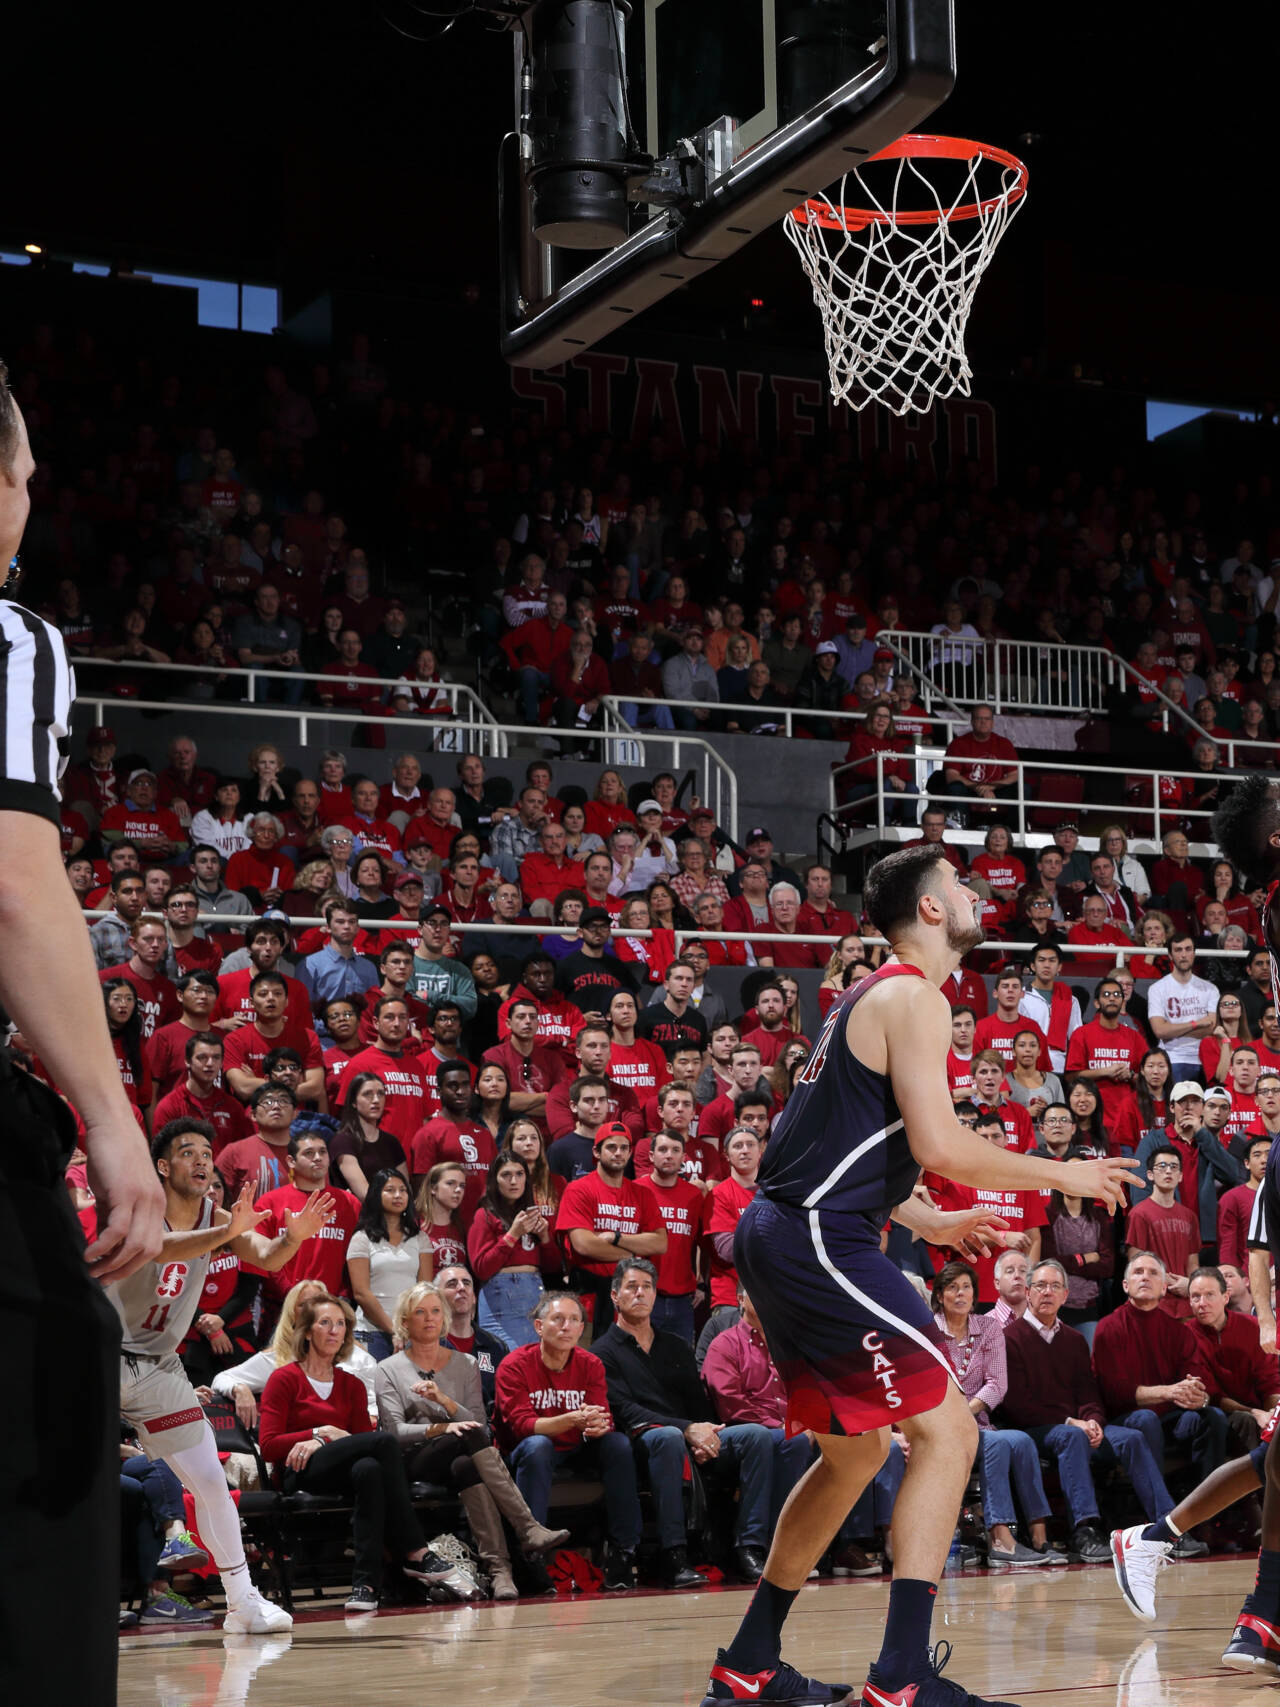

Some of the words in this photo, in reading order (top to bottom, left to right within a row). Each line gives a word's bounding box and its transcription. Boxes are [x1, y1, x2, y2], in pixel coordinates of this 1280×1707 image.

[438, 728, 458, 750] 12
[621, 741, 636, 762] 11
[1094, 1047, 1118, 1058] HOME
[1119, 1049, 1130, 1059] OF
[611, 1064, 637, 1075] HOME
[637, 1063, 650, 1074] OF
[384, 1071, 411, 1083] HOME
[977, 1190, 1003, 1203] HOME
[1004, 1193, 1017, 1204] OF
[597, 1203, 622, 1218] HOME
[622, 1207, 637, 1219] OF
[676, 1208, 688, 1220] OF
[142, 1304, 172, 1332] 11
[861, 1331, 904, 1409] CATS
